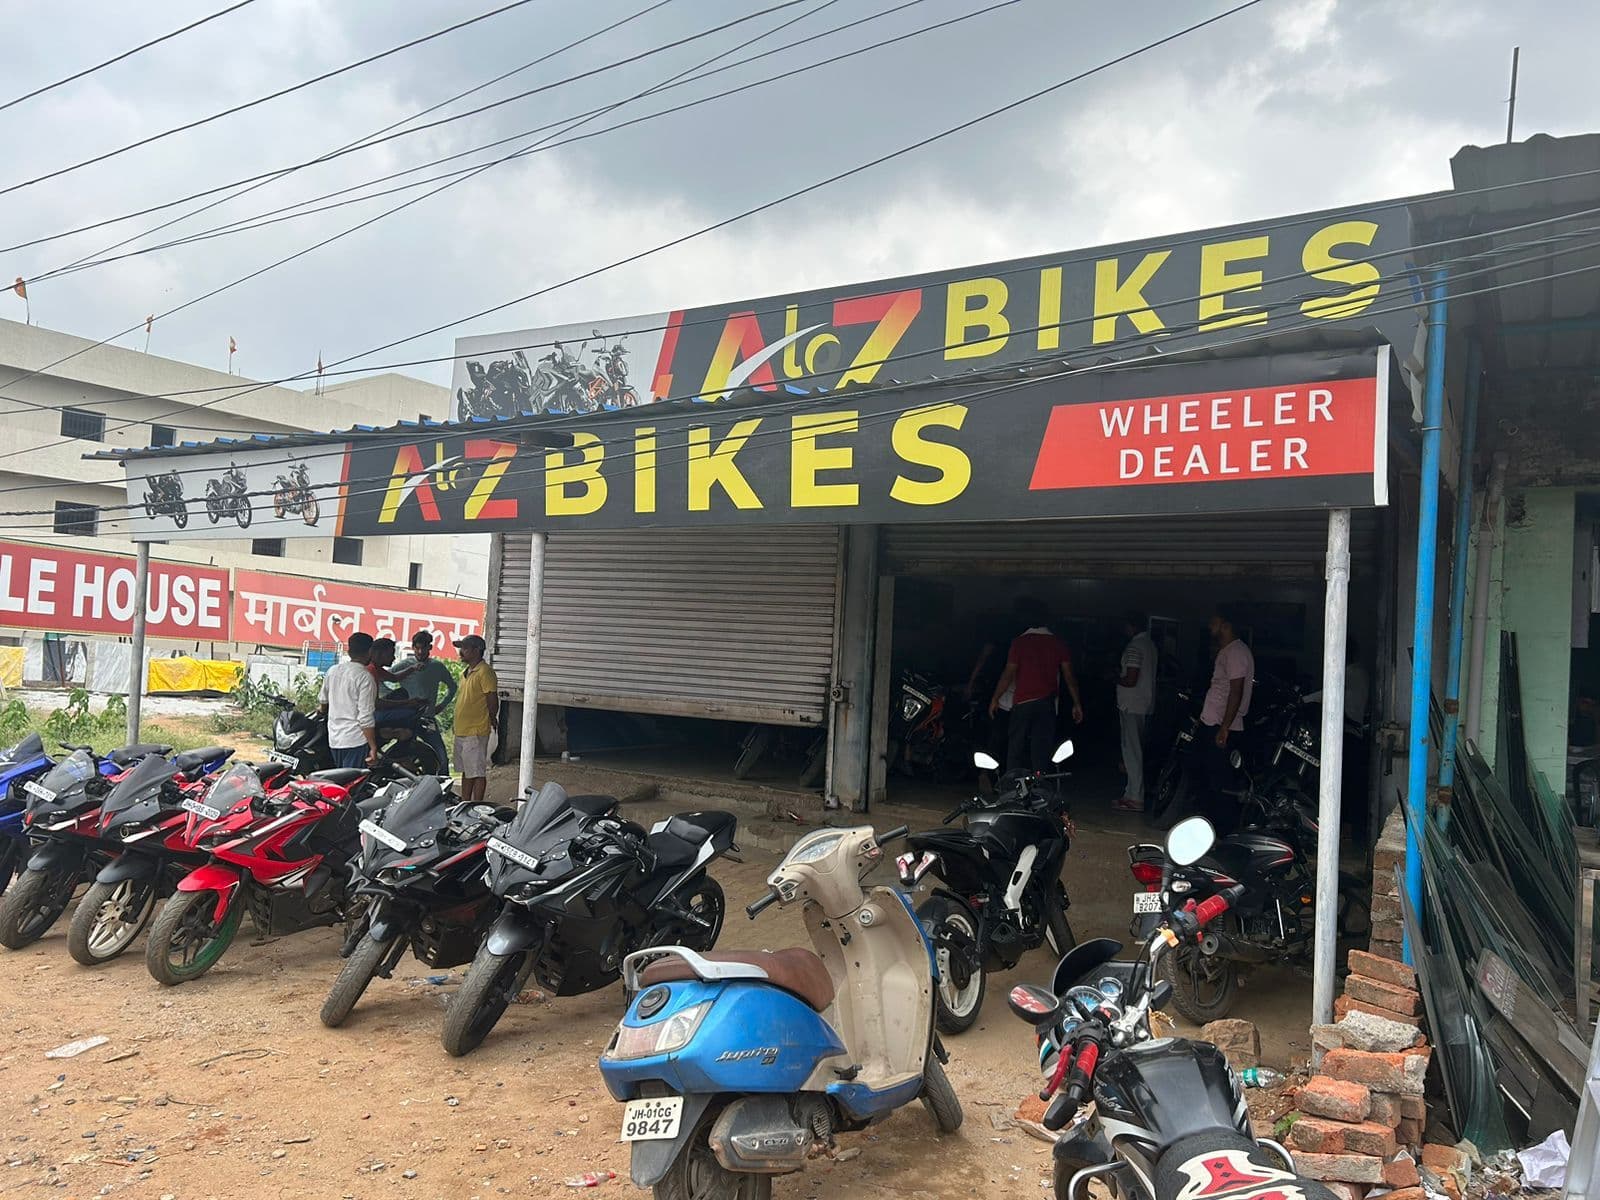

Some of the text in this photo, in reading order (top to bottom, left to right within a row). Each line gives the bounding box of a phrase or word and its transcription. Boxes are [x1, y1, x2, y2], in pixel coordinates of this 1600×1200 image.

[943, 220, 1382, 362] BIKES
[1099, 389, 1334, 438] WHEELER
[544, 402, 972, 517] BIKES
[1119, 437, 1309, 479] DEALER
[72, 563, 222, 629] HOUSE
[239, 583, 366, 643] मार्बल
[626, 1118, 674, 1137] 9847
[632, 1106, 672, 1120] JH-01CG
